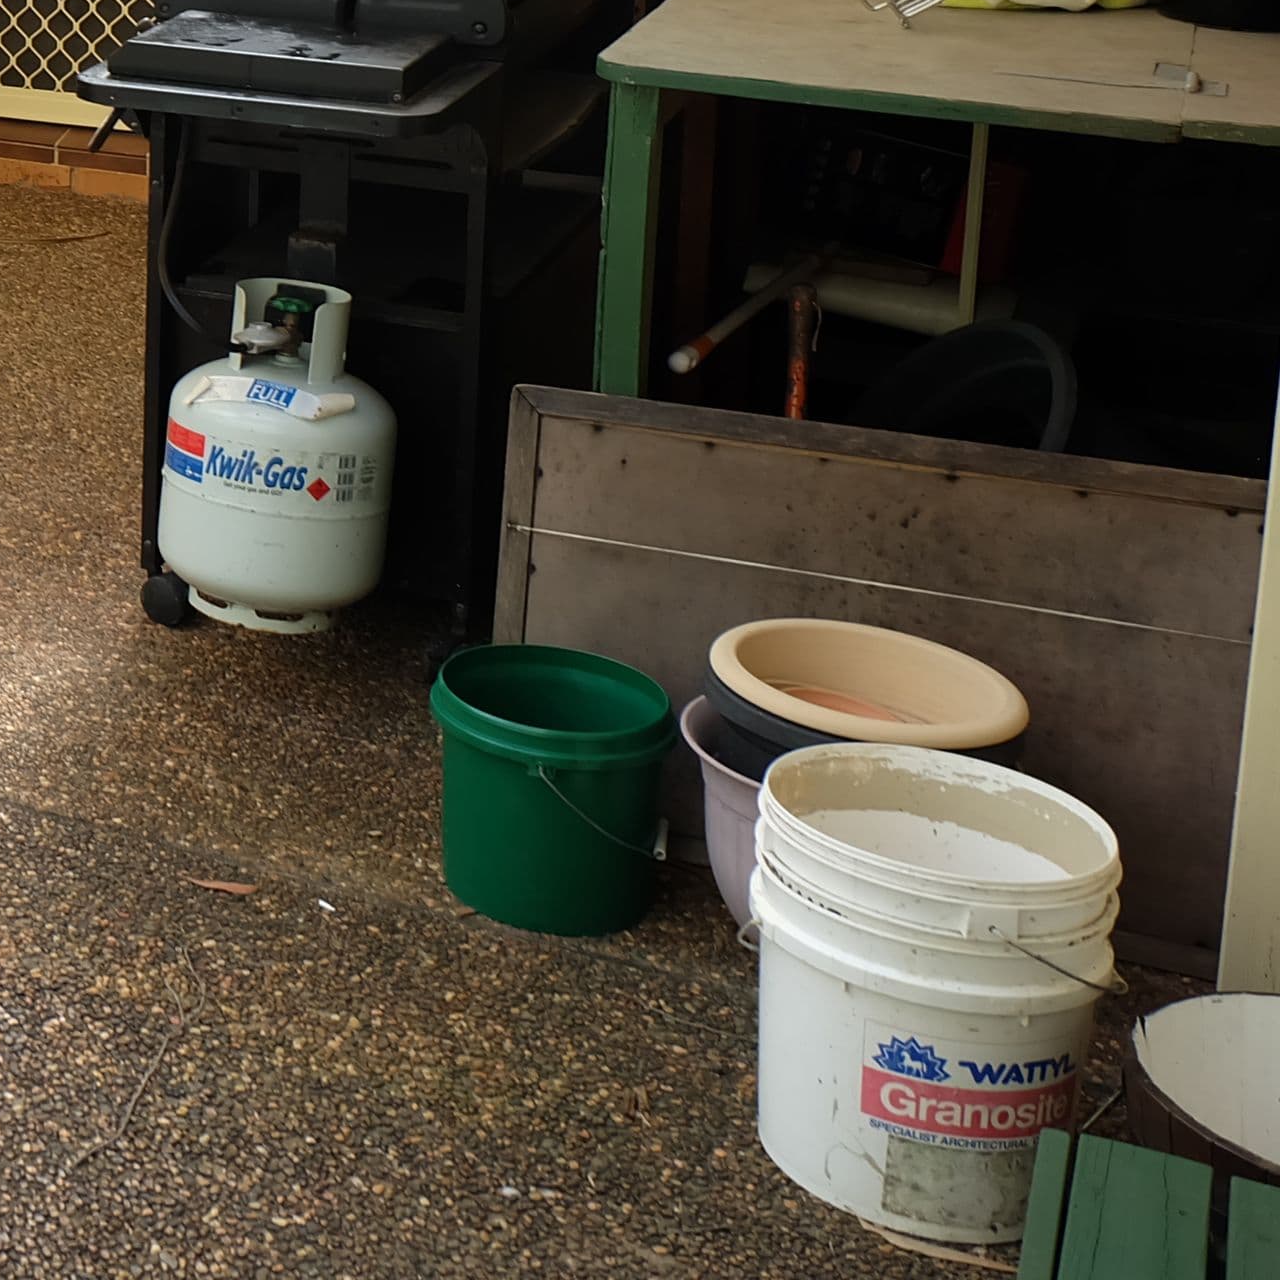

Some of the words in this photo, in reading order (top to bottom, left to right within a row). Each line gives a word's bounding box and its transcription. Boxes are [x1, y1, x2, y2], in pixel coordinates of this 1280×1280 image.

[250, 384, 287, 406] FULL
[206, 444, 308, 491] Kwik-Gas
[958, 1052, 1075, 1085] WATTYL
[880, 1081, 1068, 1131] Granosite
[869, 1118, 936, 1143] SPECIALIST
[941, 1135, 1029, 1150] ARCHITECTURAL
